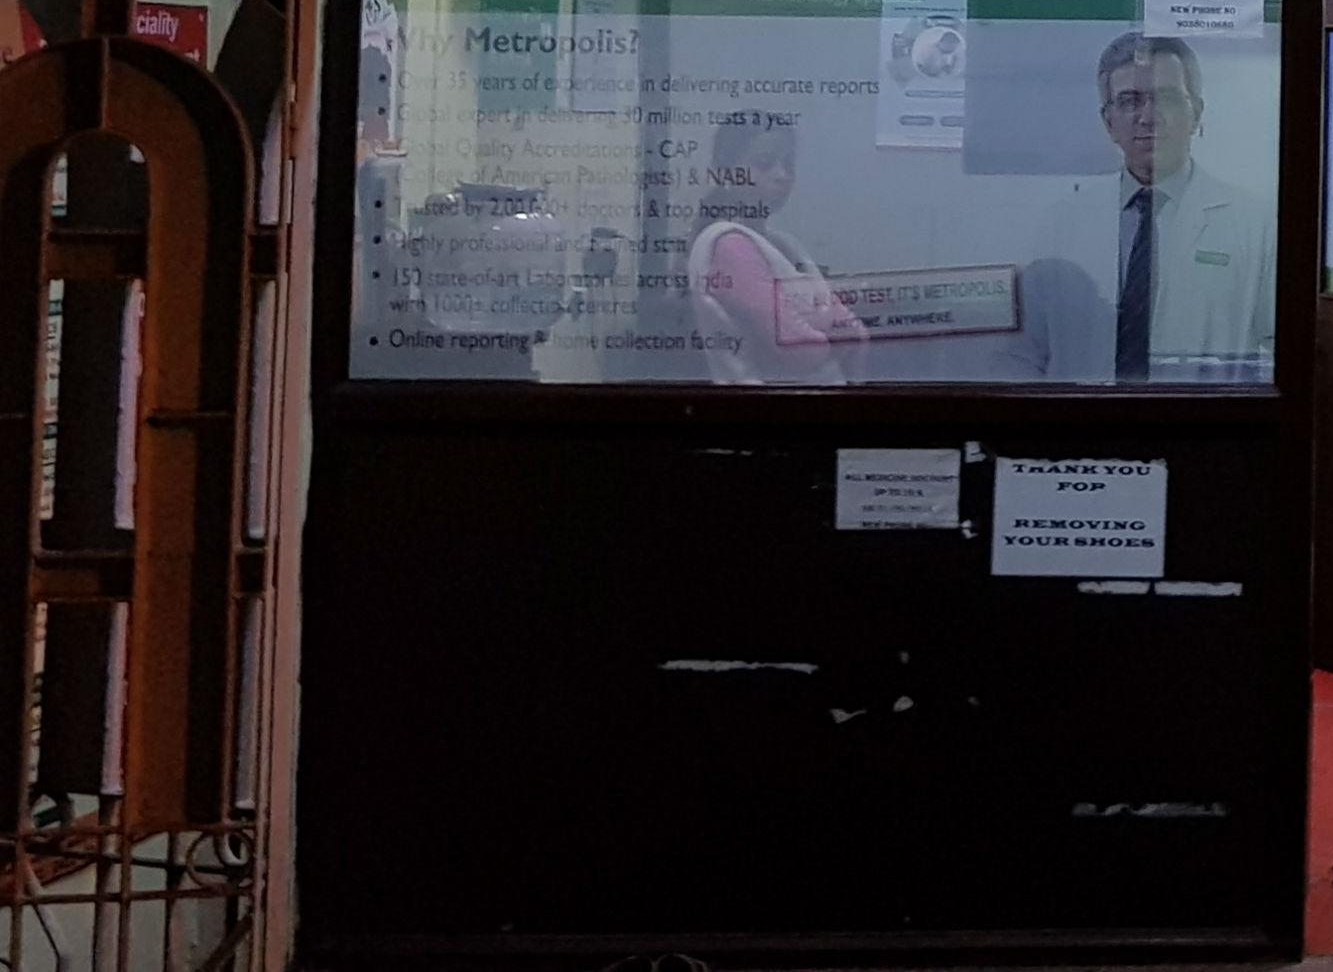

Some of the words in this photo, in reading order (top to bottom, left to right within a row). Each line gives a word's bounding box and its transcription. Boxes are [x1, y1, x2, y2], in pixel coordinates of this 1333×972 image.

[464, 26, 640, 56] Metropolis?
[474, 75, 518, 96] years
[523, 70, 542, 92] of
[640, 73, 656, 93] in
[661, 72, 740, 98] delivering
[744, 77, 816, 94] accurate
[820, 78, 880, 99] reports
[647, 107, 701, 126] million
[708, 110, 748, 126] tests
[766, 112, 802, 132] year
[660, 139, 699, 159] CAP
[706, 167, 756, 188] NABL
[699, 198, 771, 221] hospitals
[389, 330, 444, 352] Online
[450, 332, 529, 356] reporting
[605, 331, 687, 352] collection
[691, 331, 743, 356] facility
[1103, 464, 1152, 477] YOU
[1012, 518, 1146, 532] REMOVING
[1003, 535, 1070, 549] YOUR
[1074, 536, 1156, 549] SHOES
